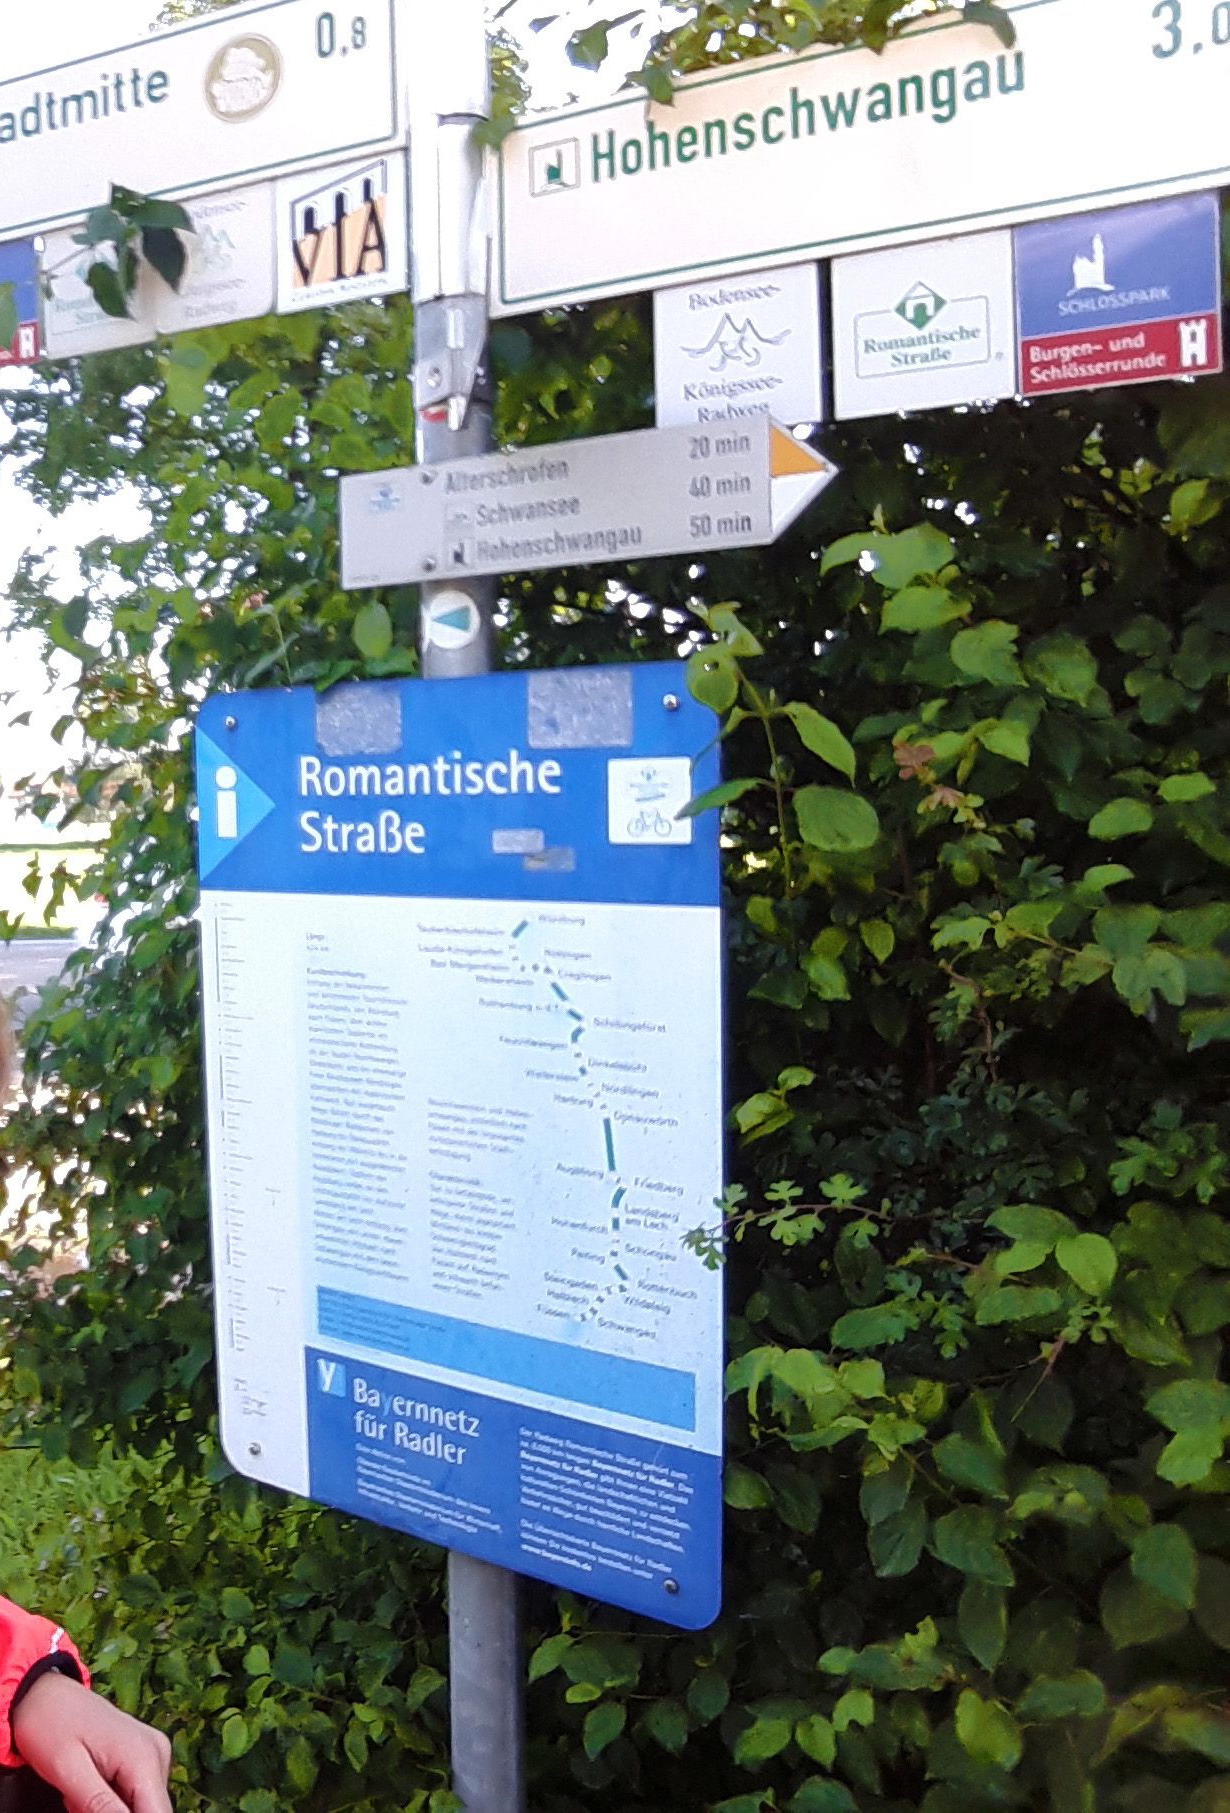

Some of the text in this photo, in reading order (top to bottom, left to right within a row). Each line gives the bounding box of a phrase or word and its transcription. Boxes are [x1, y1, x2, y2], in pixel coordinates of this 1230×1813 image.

[591, 51, 1025, 183] Hohenschwangau
[1058, 287, 1171, 317] SCHLOSSPARK
[863, 325, 982, 354] Romantische
[890, 347, 953, 368] Straße
[1029, 331, 1146, 363] Burgen- und
[1029, 352, 1168, 384] Schlösserrunde
[445, 432, 751, 494] Alterschrofen 20 min
[476, 473, 751, 527] Schwansee 40 min
[476, 512, 752, 561] Hohenschwangau 50 min
[299, 749, 562, 797] Romantische
[299, 810, 426, 855] Straße
[353, 1377, 480, 1438] Bayernnetz
[353, 1409, 467, 1466] für Radler
